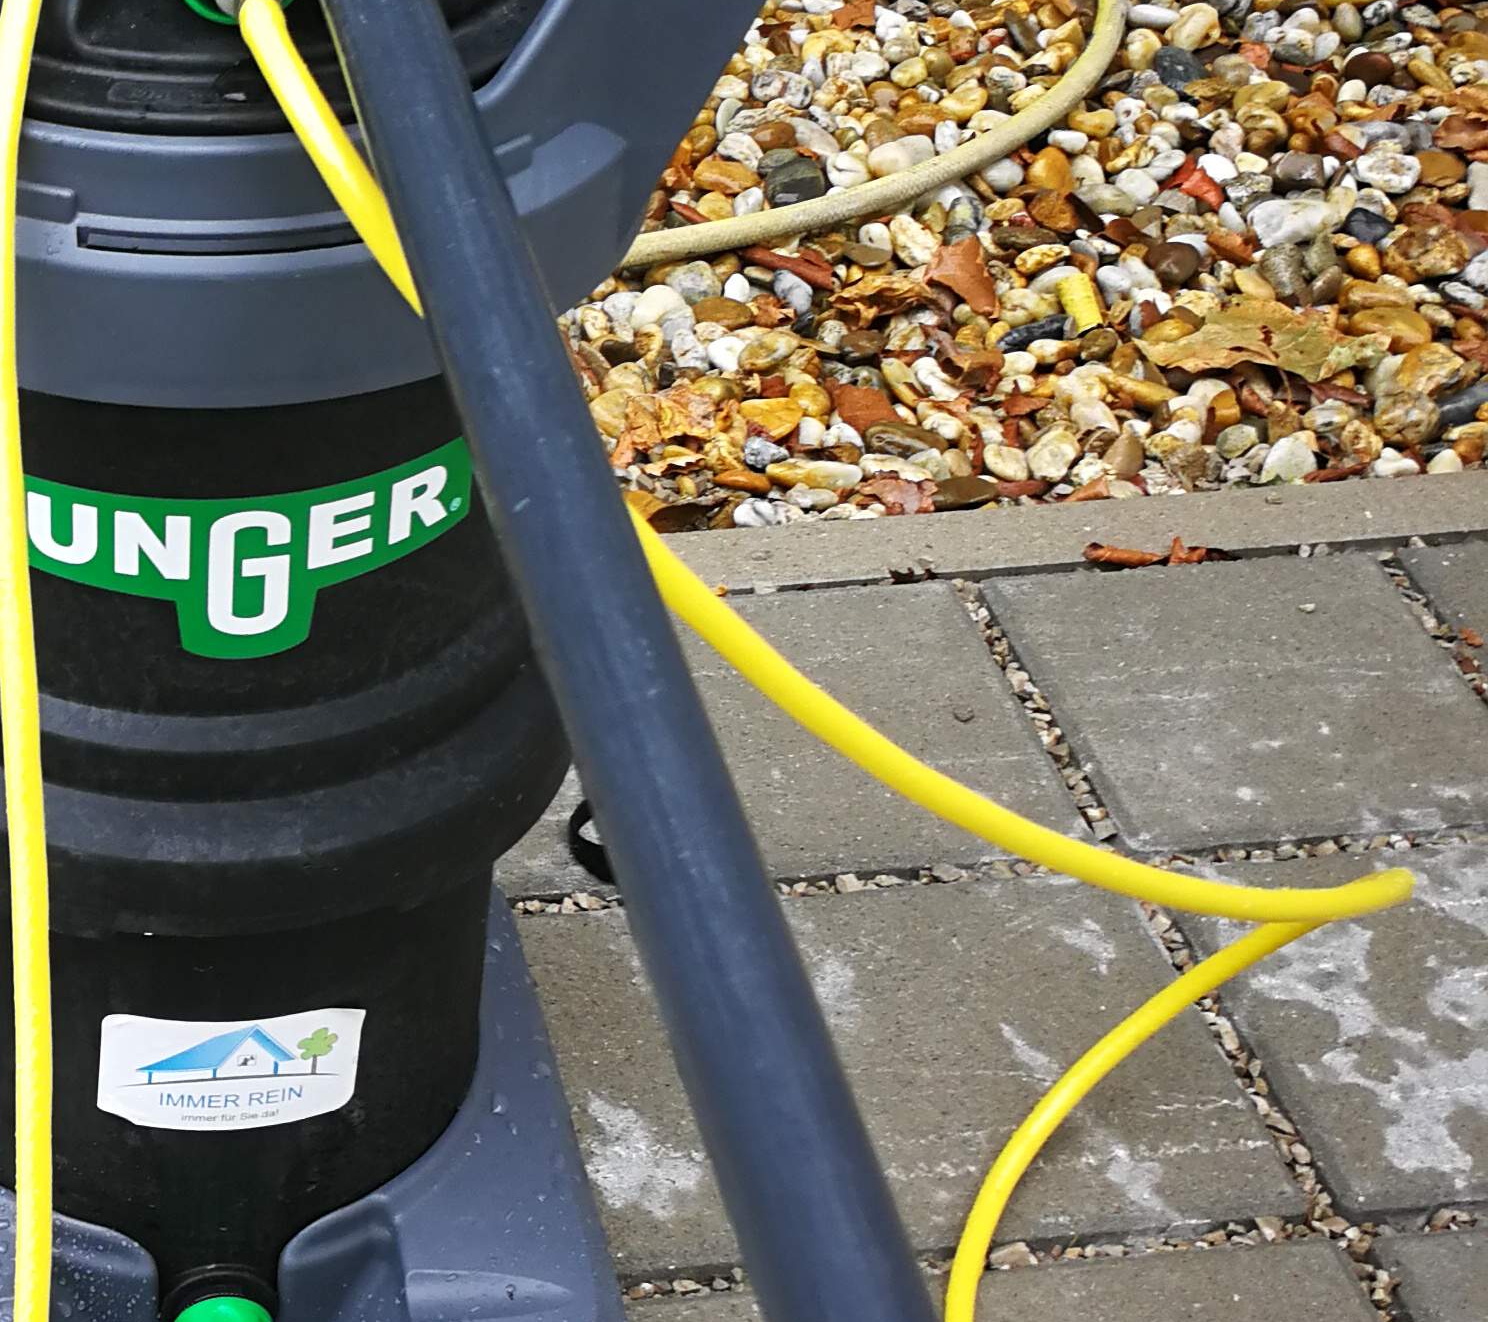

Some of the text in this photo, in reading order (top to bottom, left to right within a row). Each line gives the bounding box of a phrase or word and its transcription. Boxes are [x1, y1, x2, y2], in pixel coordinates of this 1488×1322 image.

[26, 464, 447, 635] UNGER
[158, 1084, 303, 1108] IMMER REIN
[180, 1108, 280, 1123] immer für Sie da!
